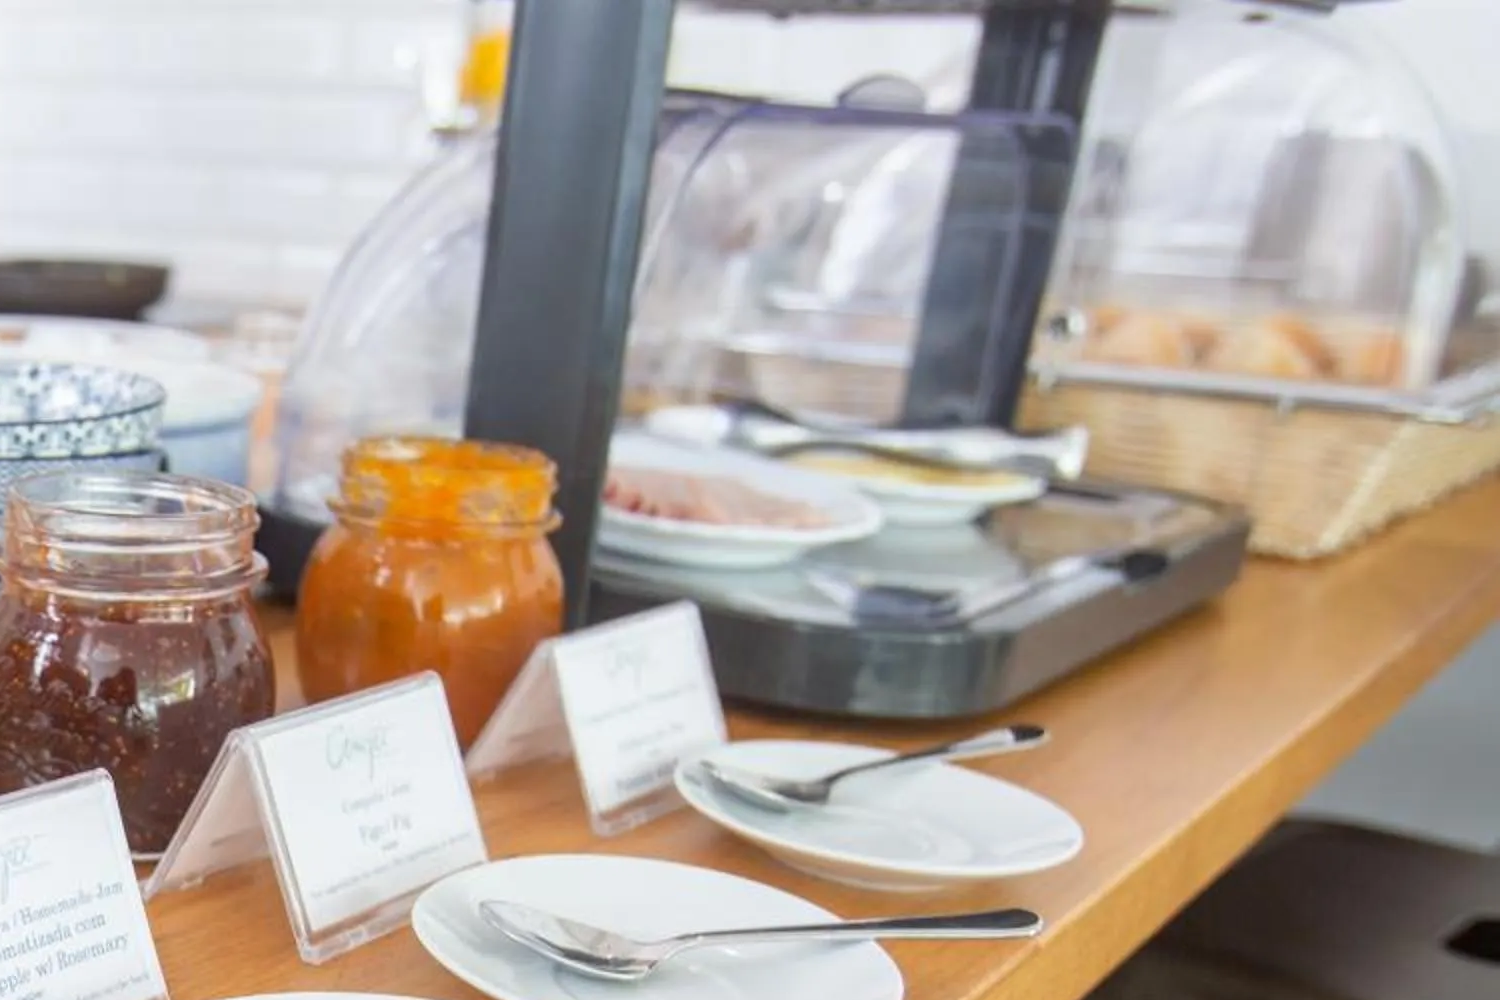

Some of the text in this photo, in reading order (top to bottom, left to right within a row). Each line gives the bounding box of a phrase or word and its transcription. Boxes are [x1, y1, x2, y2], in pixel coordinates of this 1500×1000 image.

[97, 881, 123, 899] Jam
[74, 913, 106, 935] com
[56, 932, 129, 971] Rosemary
